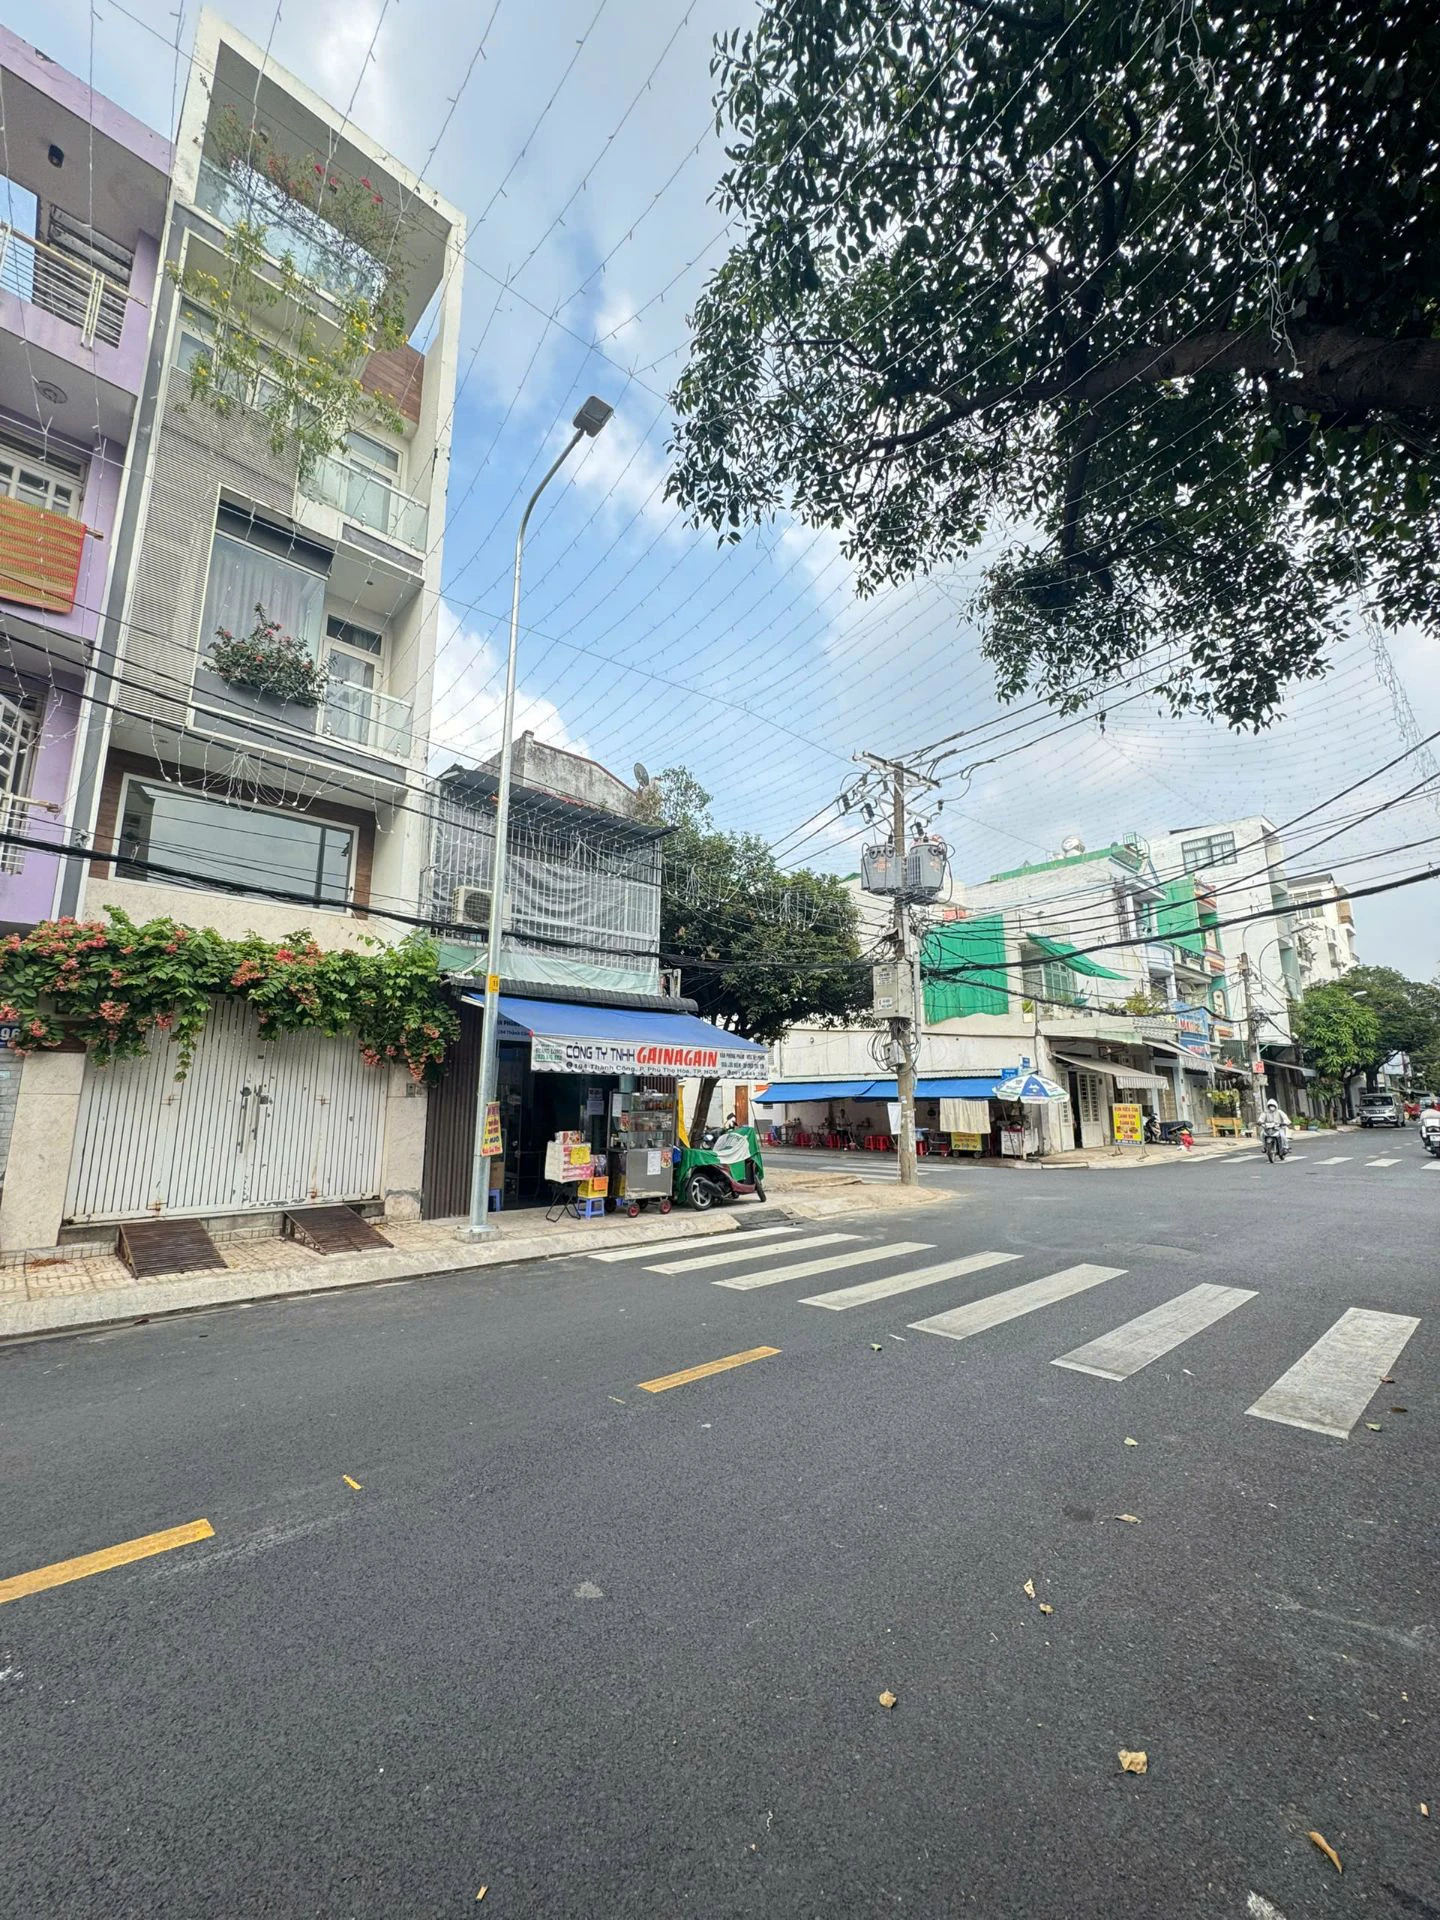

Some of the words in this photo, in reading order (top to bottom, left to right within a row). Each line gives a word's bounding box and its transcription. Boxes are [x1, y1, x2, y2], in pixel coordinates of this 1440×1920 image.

[595, 1046, 608, 1060] TY
[610, 1047, 635, 1062] TNHH
[636, 1046, 718, 1068] GAINAGAIN
